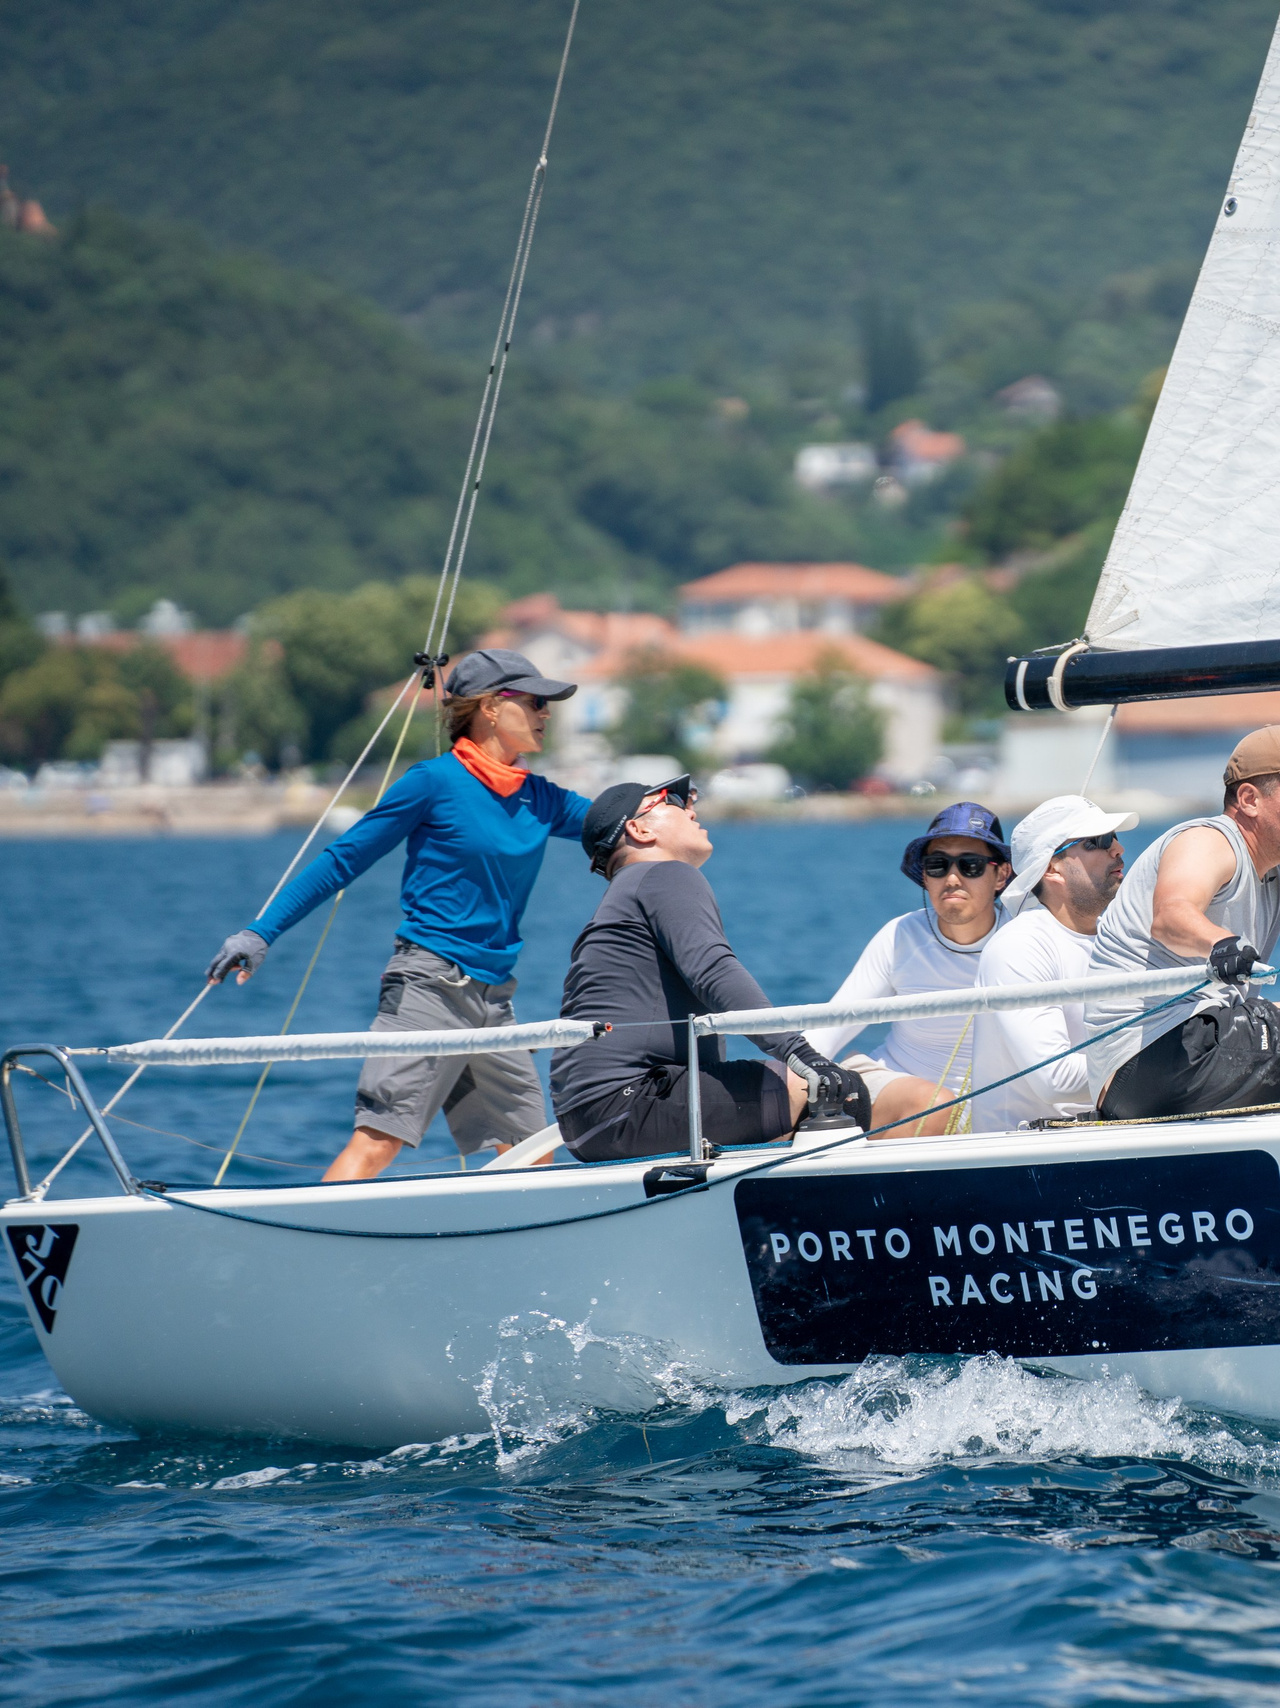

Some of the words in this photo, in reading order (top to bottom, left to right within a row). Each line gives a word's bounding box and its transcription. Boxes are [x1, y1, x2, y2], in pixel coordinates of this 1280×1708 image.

[770, 1227, 910, 1263] PORTO
[933, 1207, 1255, 1257] MONTENEGRO
[927, 1268, 1099, 1306] RACING
